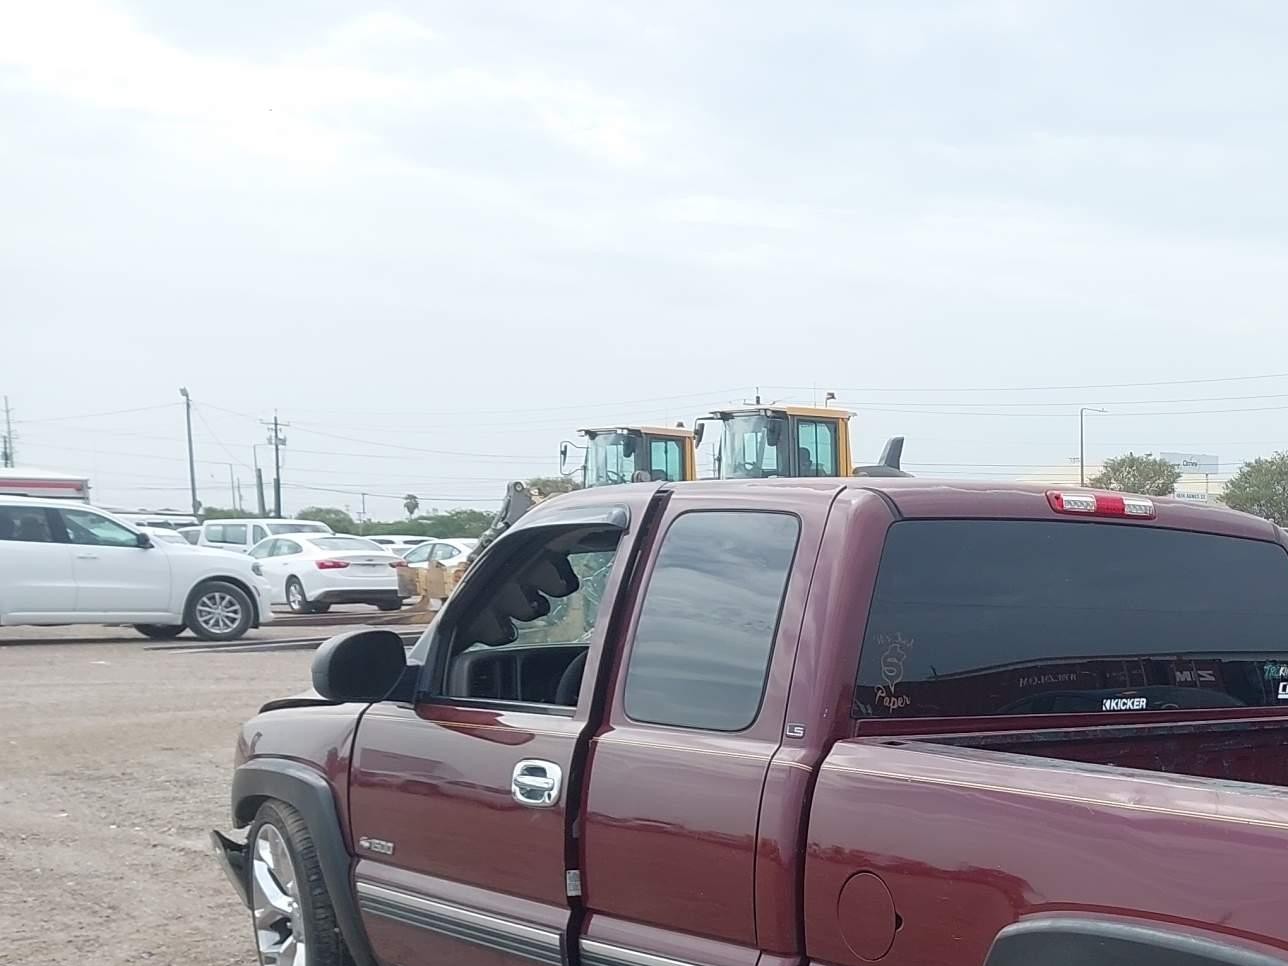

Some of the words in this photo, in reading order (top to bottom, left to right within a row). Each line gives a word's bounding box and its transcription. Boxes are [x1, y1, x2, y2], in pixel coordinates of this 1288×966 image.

[874, 684, 911, 713] Paper
[1110, 698, 1147, 710] KICKER
[786, 723, 804, 737] LS
